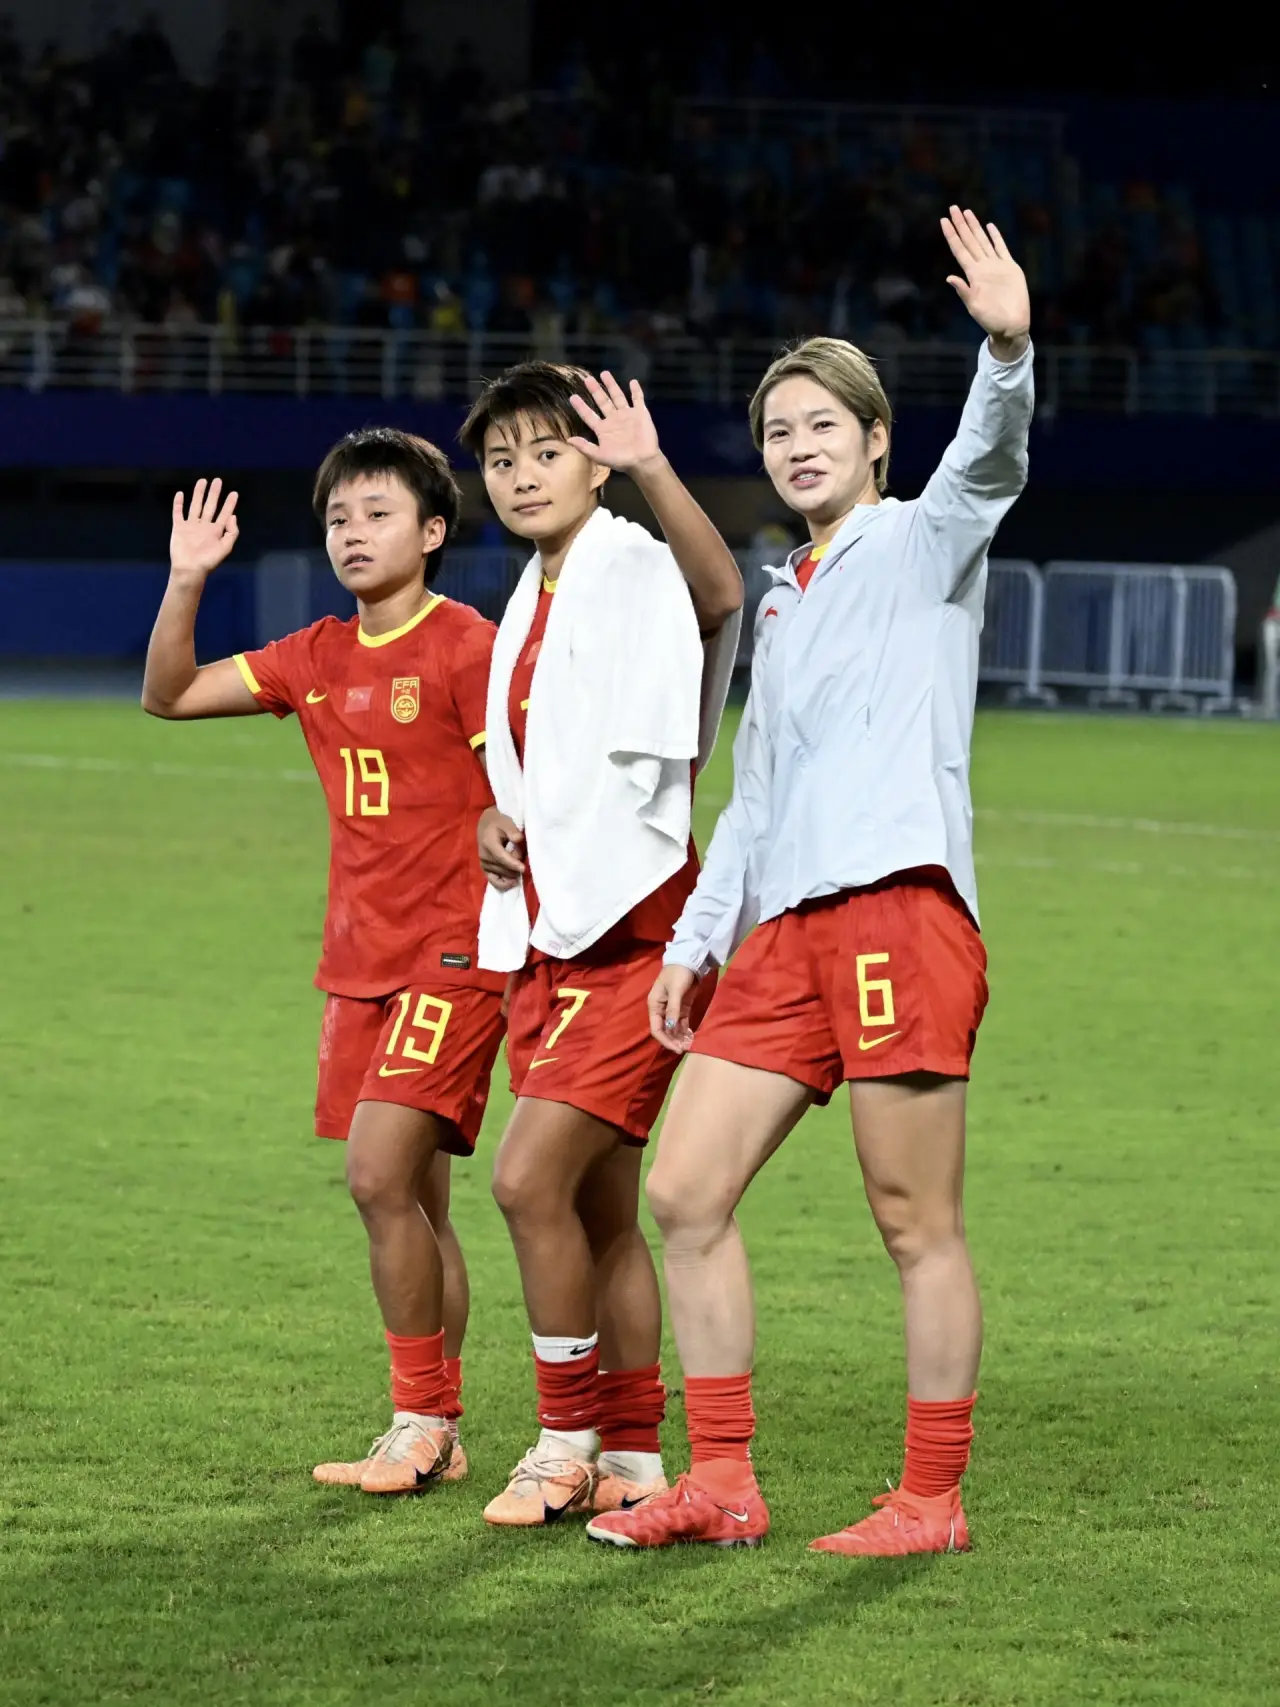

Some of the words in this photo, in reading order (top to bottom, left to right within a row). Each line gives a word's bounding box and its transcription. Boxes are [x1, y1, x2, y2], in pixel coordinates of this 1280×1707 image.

[395, 680, 418, 690] CFA
[339, 748, 389, 816] 19
[545, 988, 591, 1049] 7
[856, 952, 895, 1026] 6
[385, 992, 453, 1065] 19
